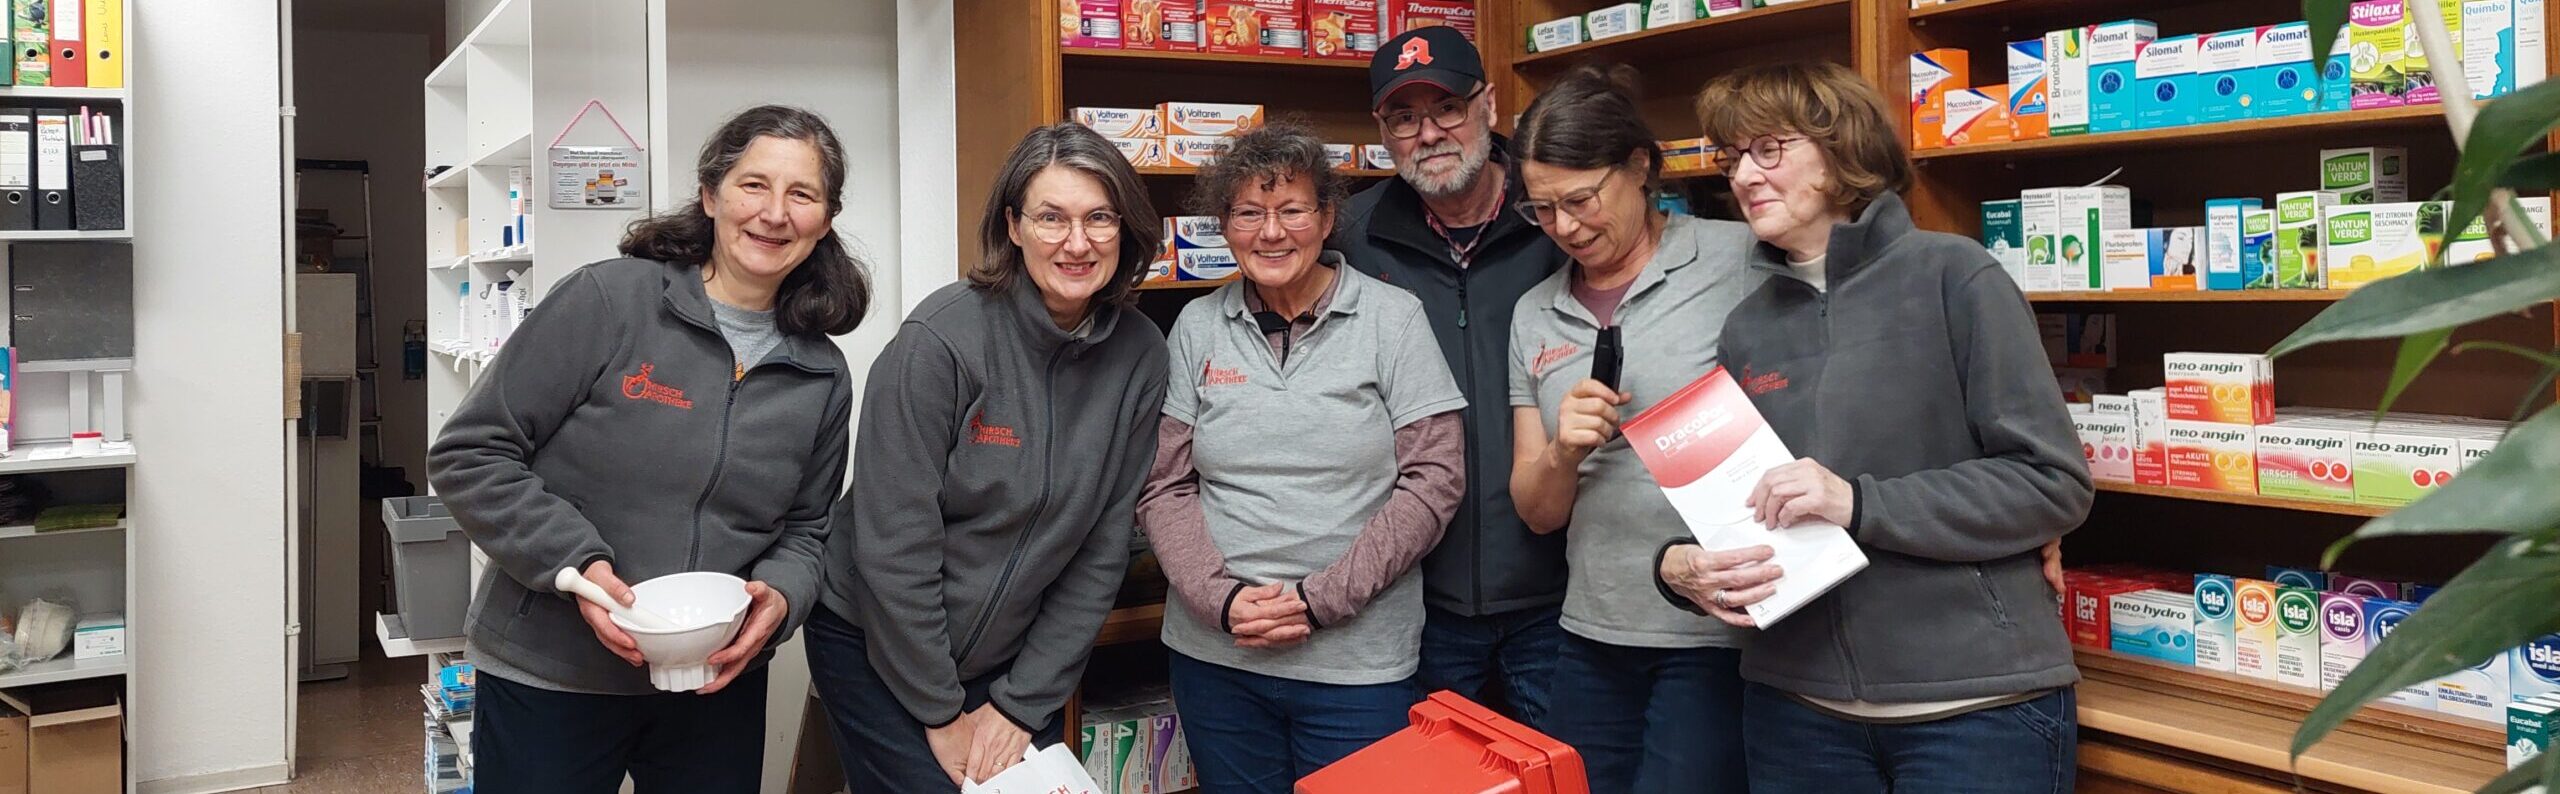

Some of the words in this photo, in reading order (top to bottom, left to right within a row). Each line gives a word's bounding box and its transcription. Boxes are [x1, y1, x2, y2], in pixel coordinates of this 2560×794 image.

[2351, 3, 2401, 20] Stilaxx
[2465, 3, 2506, 15] Quimbo
[2092, 31, 2129, 44] Silomat
[2266, 29, 2308, 43] Silomat
[2146, 44, 2183, 57] Silomat
[2207, 38, 2245, 51] Silomat
[2051, 35, 2061, 98] Bronchicum
[2063, 89, 2082, 98] Elixir
[1946, 99, 1983, 109] Mucosolvan
[1096, 109, 1129, 119] Voltaren
[1187, 108, 1222, 118] Voltaren
[2327, 161, 2367, 173] TANTUM
[2331, 170, 2363, 182] VERDE
[2281, 201, 2312, 211] TANTUM
[2286, 209, 2309, 219] VERDE
[2330, 218, 2368, 230] TANTUM
[2375, 220, 2409, 228] GESCHMACK
[2334, 228, 2365, 239] VERDE
[1196, 254, 1230, 263] Voltaren
[2168, 361, 2197, 370] neo
[2199, 361, 2243, 374] angin
[2184, 385, 2208, 394] AKUTE
[2098, 402, 2122, 411] neo
[2086, 423, 2126, 434] angin
[2170, 428, 2198, 438] neo
[2201, 429, 2246, 442] angin
[2260, 435, 2291, 445] neo
[2295, 437, 2343, 449] angin
[2355, 441, 2391, 452] neo
[2394, 443, 2449, 457] angin
[2185, 452, 2210, 461] AKUTE
[2261, 468, 2299, 479] KIRSCHE
[2202, 590, 2225, 607] isla
[2243, 596, 2266, 613] isla
[2113, 601, 2141, 613] neo
[2143, 605, 2187, 620] hydro
[2283, 603, 2309, 620] isla
[2329, 609, 2356, 628] isla
[2438, 694, 2493, 708] HALSBESCHWERDEN
[2476, 693, 2488, 701] UND
[2510, 715, 2543, 728] Eucabal
